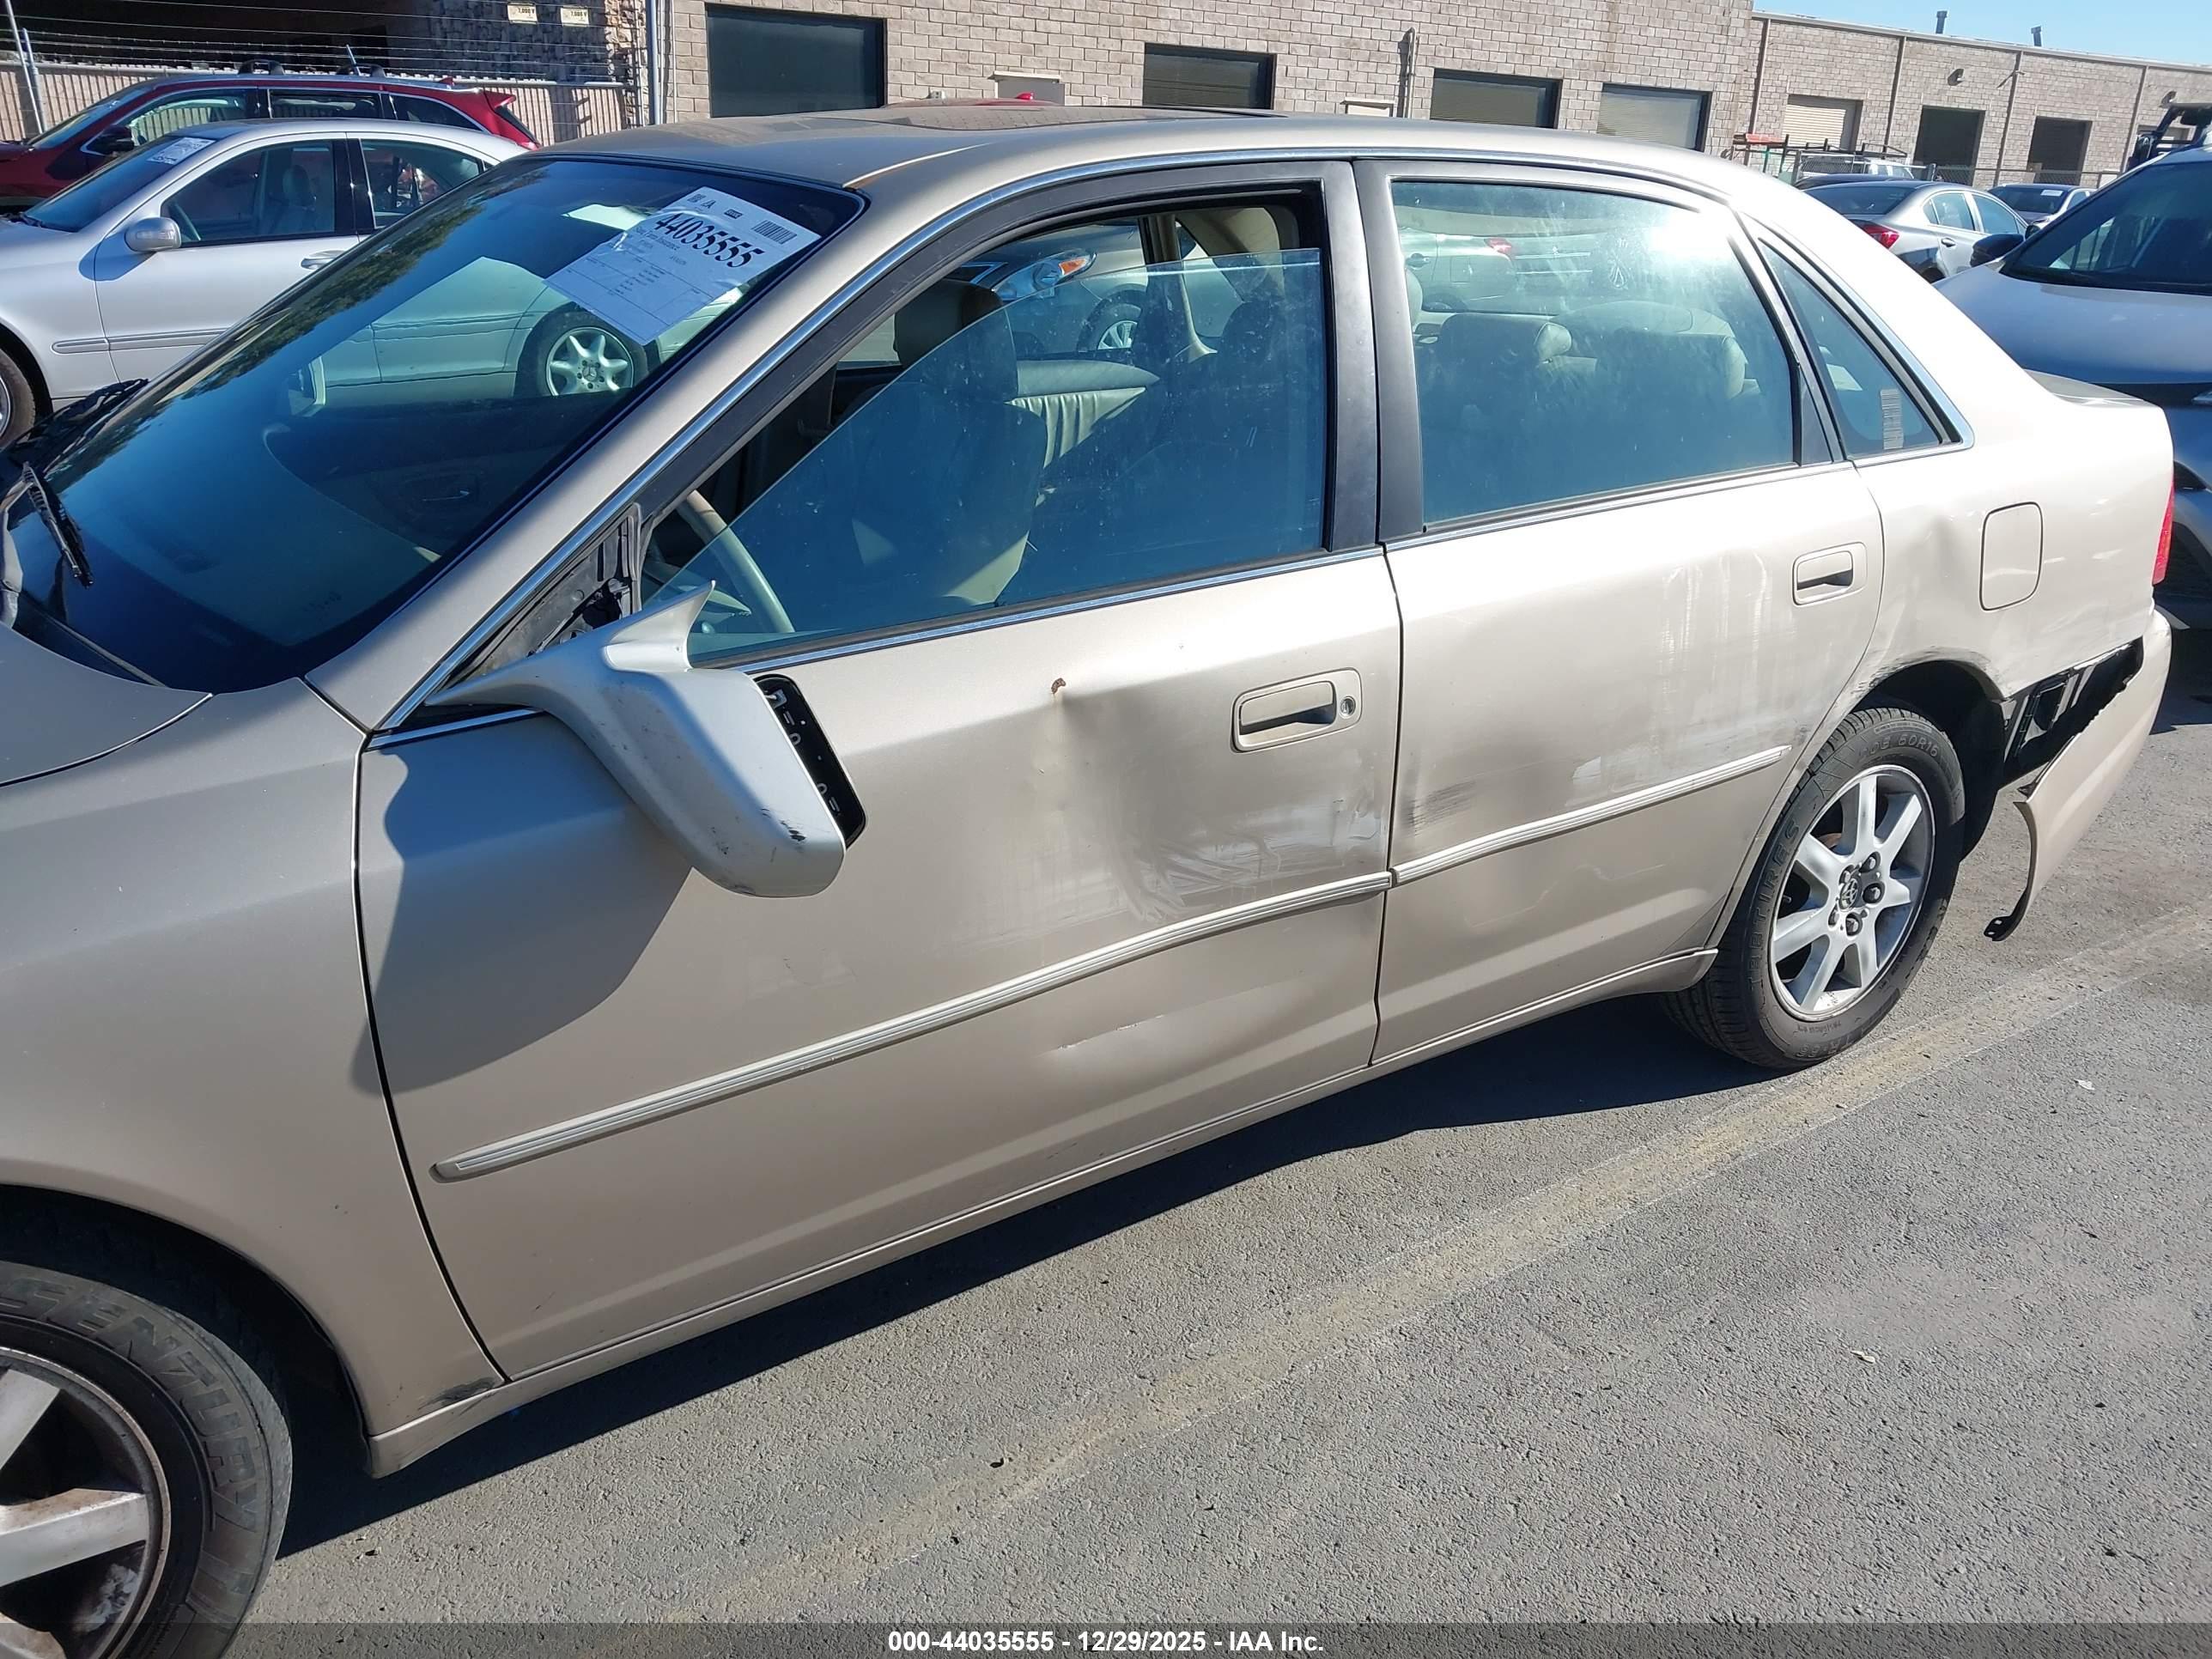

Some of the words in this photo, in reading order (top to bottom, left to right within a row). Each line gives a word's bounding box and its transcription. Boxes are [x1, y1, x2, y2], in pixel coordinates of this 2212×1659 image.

[654, 213, 764, 268] 44035555
[1753, 818, 1800, 926] TIRES
[0, 1275, 259, 1533] SENTURY
